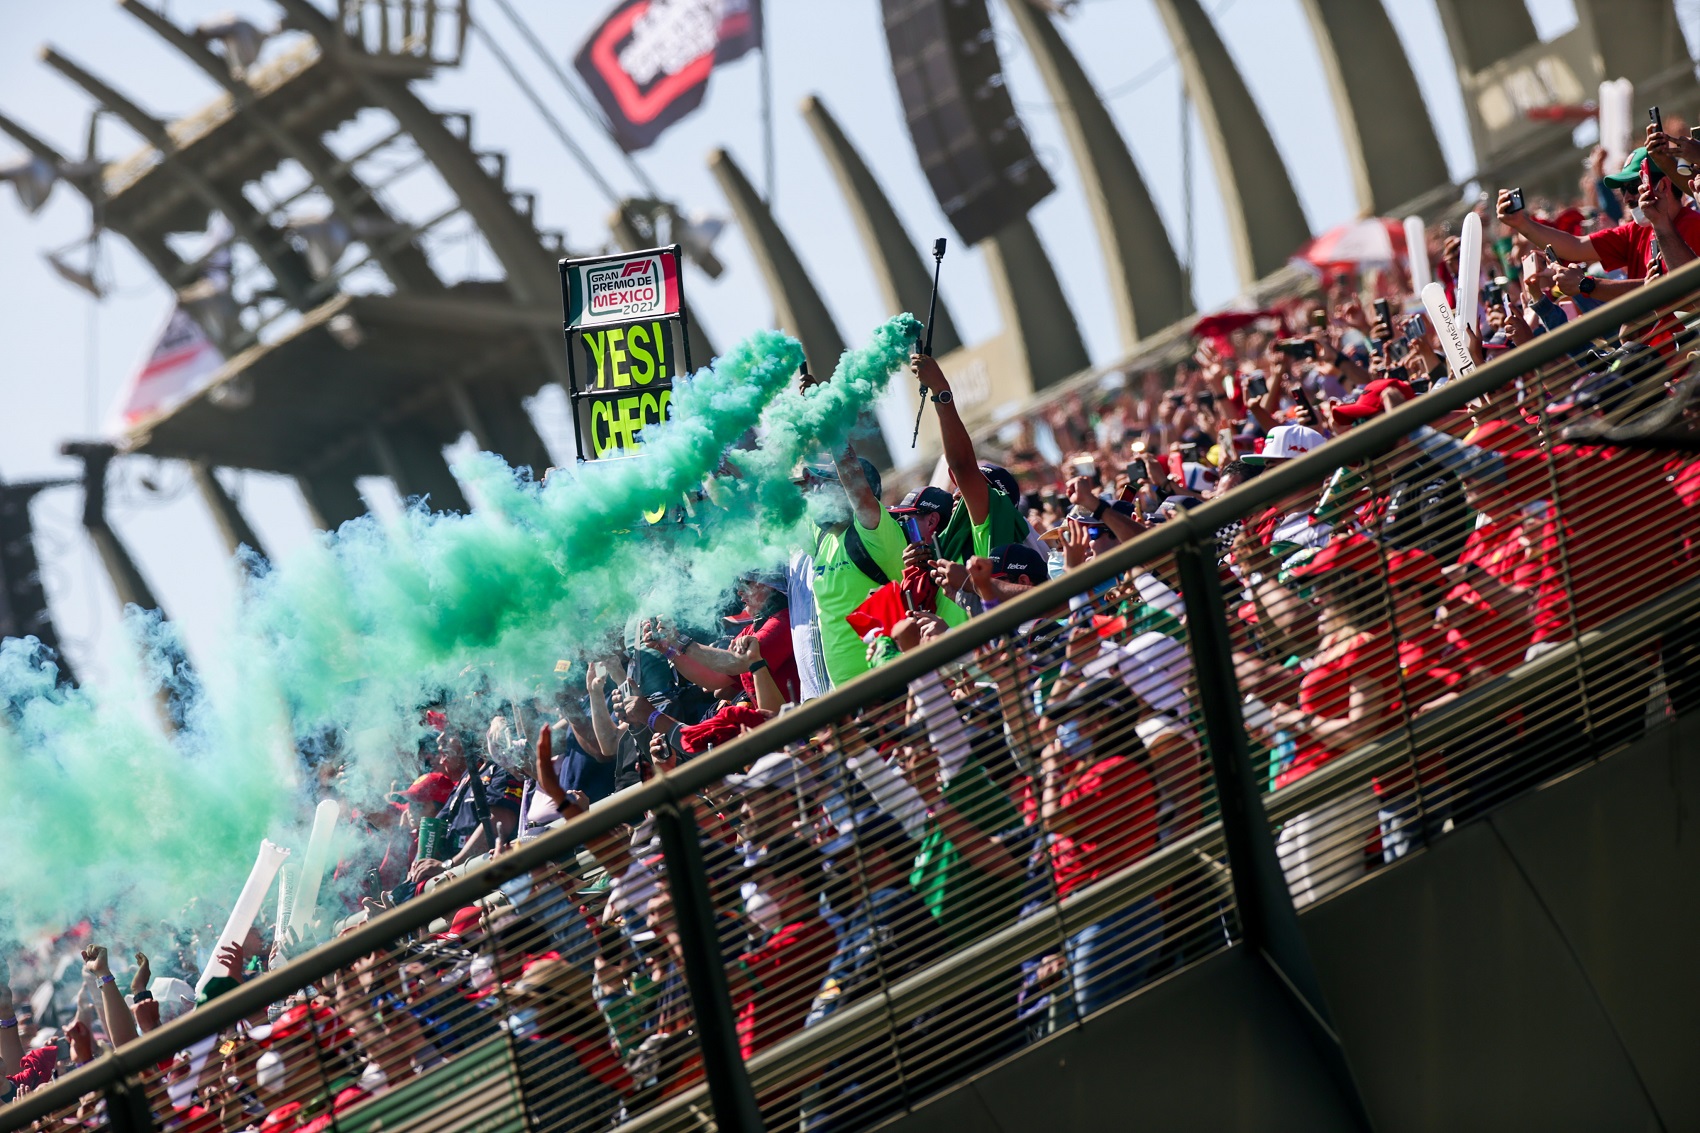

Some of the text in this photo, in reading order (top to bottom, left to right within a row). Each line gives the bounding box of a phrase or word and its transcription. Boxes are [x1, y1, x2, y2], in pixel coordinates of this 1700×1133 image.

[591, 271, 619, 283] GRAN
[593, 276, 652, 293] PREMIO DE
[593, 287, 654, 308] MÉXICO
[623, 302, 654, 315] 2021
[582, 322, 667, 388] YES!
[919, 500, 940, 510] telcel
[1007, 562, 1028, 570] telcel
